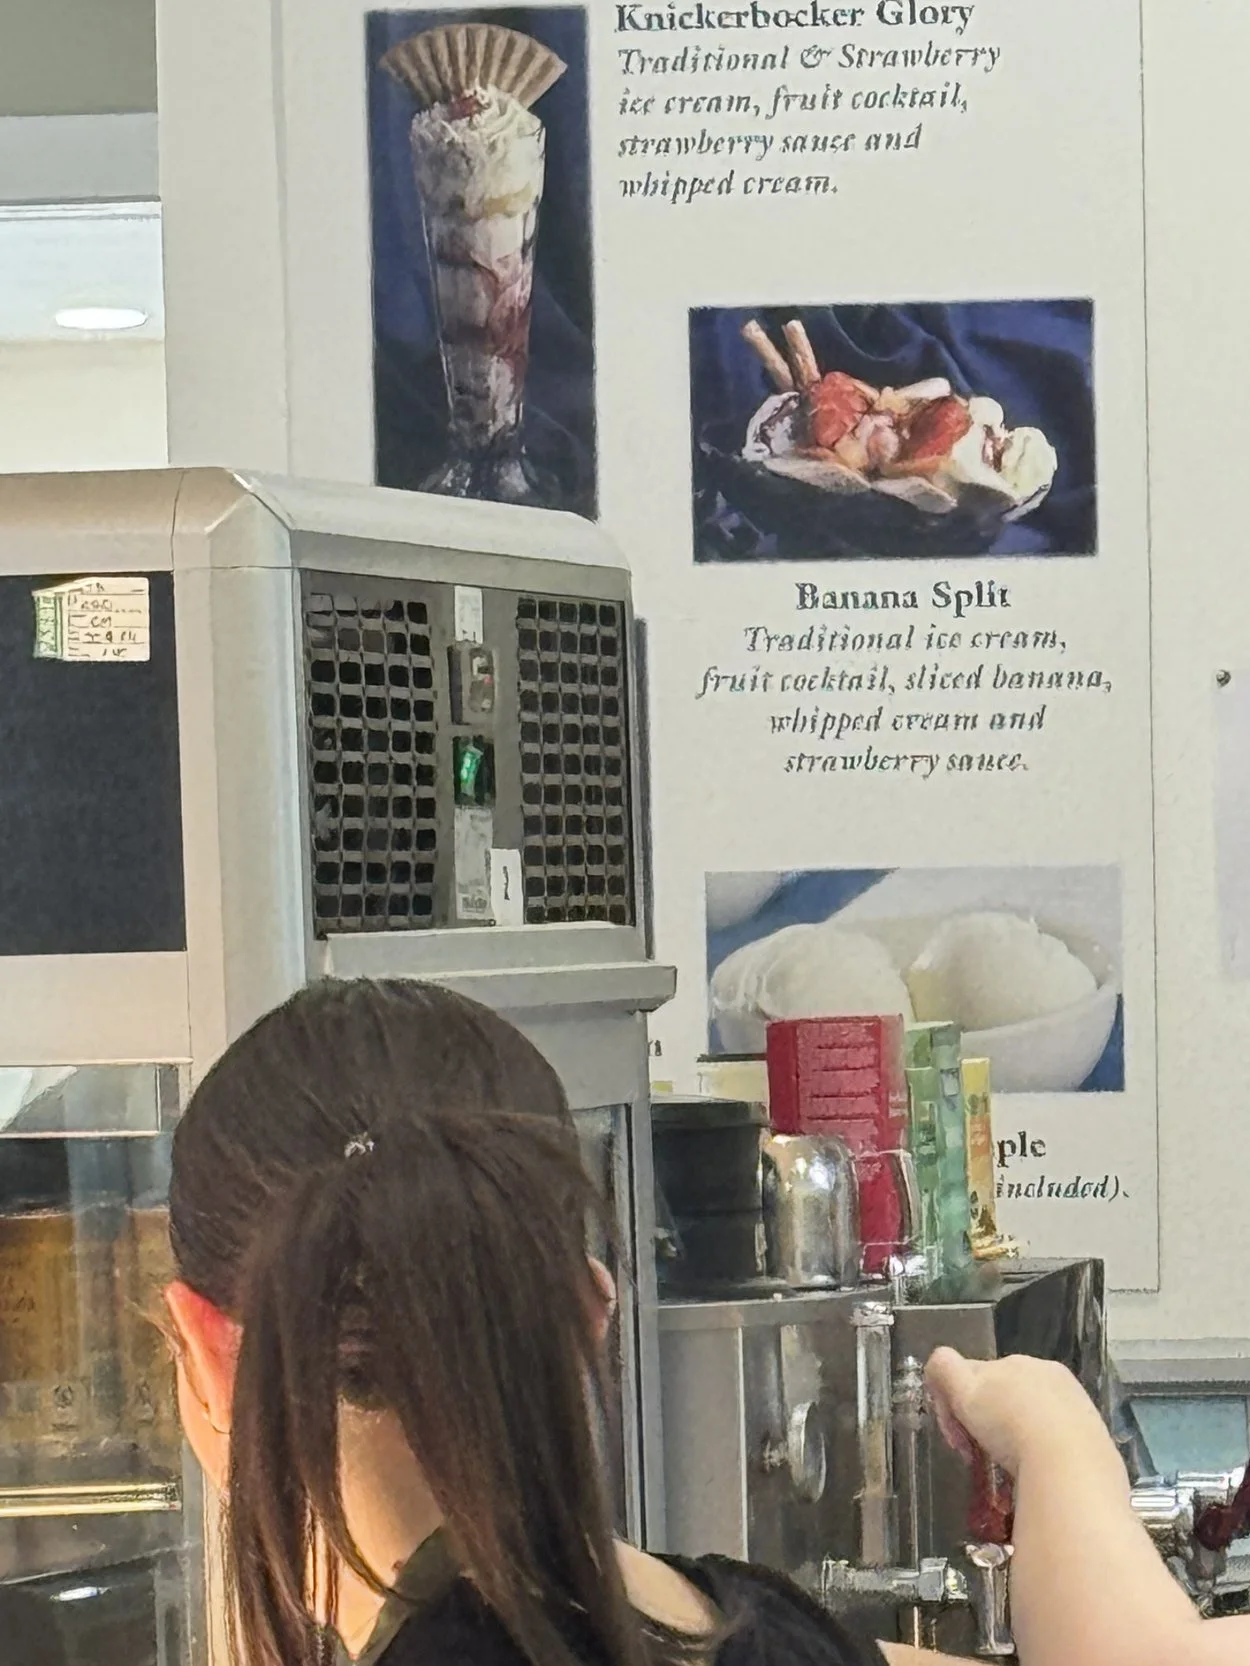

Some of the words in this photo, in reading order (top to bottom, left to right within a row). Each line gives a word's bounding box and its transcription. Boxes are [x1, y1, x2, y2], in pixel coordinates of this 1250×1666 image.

[614, 0, 865, 33] Knickerbocker
[876, 0, 975, 36] Glory
[618, 44, 789, 75] Traditional
[800, 45, 832, 69] &
[838, 40, 1000, 73] Strawberry
[619, 88, 655, 115] ice
[664, 95, 760, 117] cream,
[765, 83, 843, 120] fruit
[851, 81, 967, 113] cocktail,
[618, 129, 774, 161] strawberry
[782, 133, 856, 153] sauce
[865, 123, 922, 151] and
[619, 169, 734, 204] whipped
[744, 176, 837, 194] cream.
[795, 583, 918, 610] Banana
[932, 580, 1011, 618] Split
[744, 624, 915, 653] Traditional
[924, 623, 961, 650] ice
[970, 630, 1066, 654] cream,
[695, 666, 773, 700] fruit
[781, 665, 895, 695] cocktail,
[905, 663, 984, 690] sliced
[992, 664, 1111, 692] banana,
[771, 706, 883, 740] whipped
[891, 713, 978, 731] cream
[989, 704, 1047, 731] and
[784, 745, 940, 780] strawberry
[946, 753, 1028, 771] sauce.
[991, 1131, 1046, 1167] ple
